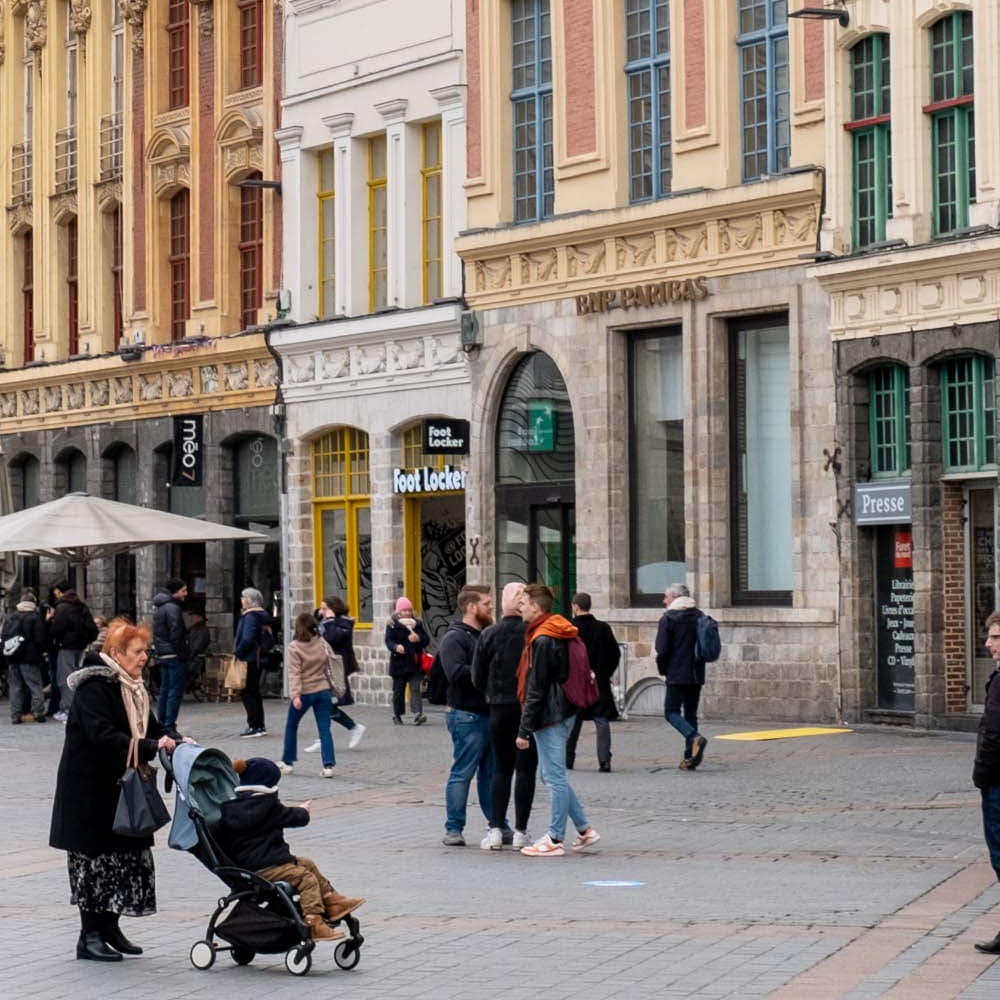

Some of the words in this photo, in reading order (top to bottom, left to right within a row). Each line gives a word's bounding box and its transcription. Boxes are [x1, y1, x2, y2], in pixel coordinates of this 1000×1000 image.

[620, 276, 708, 311] PARIBAS
[428, 426, 452, 437] Foot
[428, 437, 464, 448] Locker
[393, 468, 421, 493] Foot
[423, 465, 467, 491] Locker
[862, 494, 905, 513] Presse
